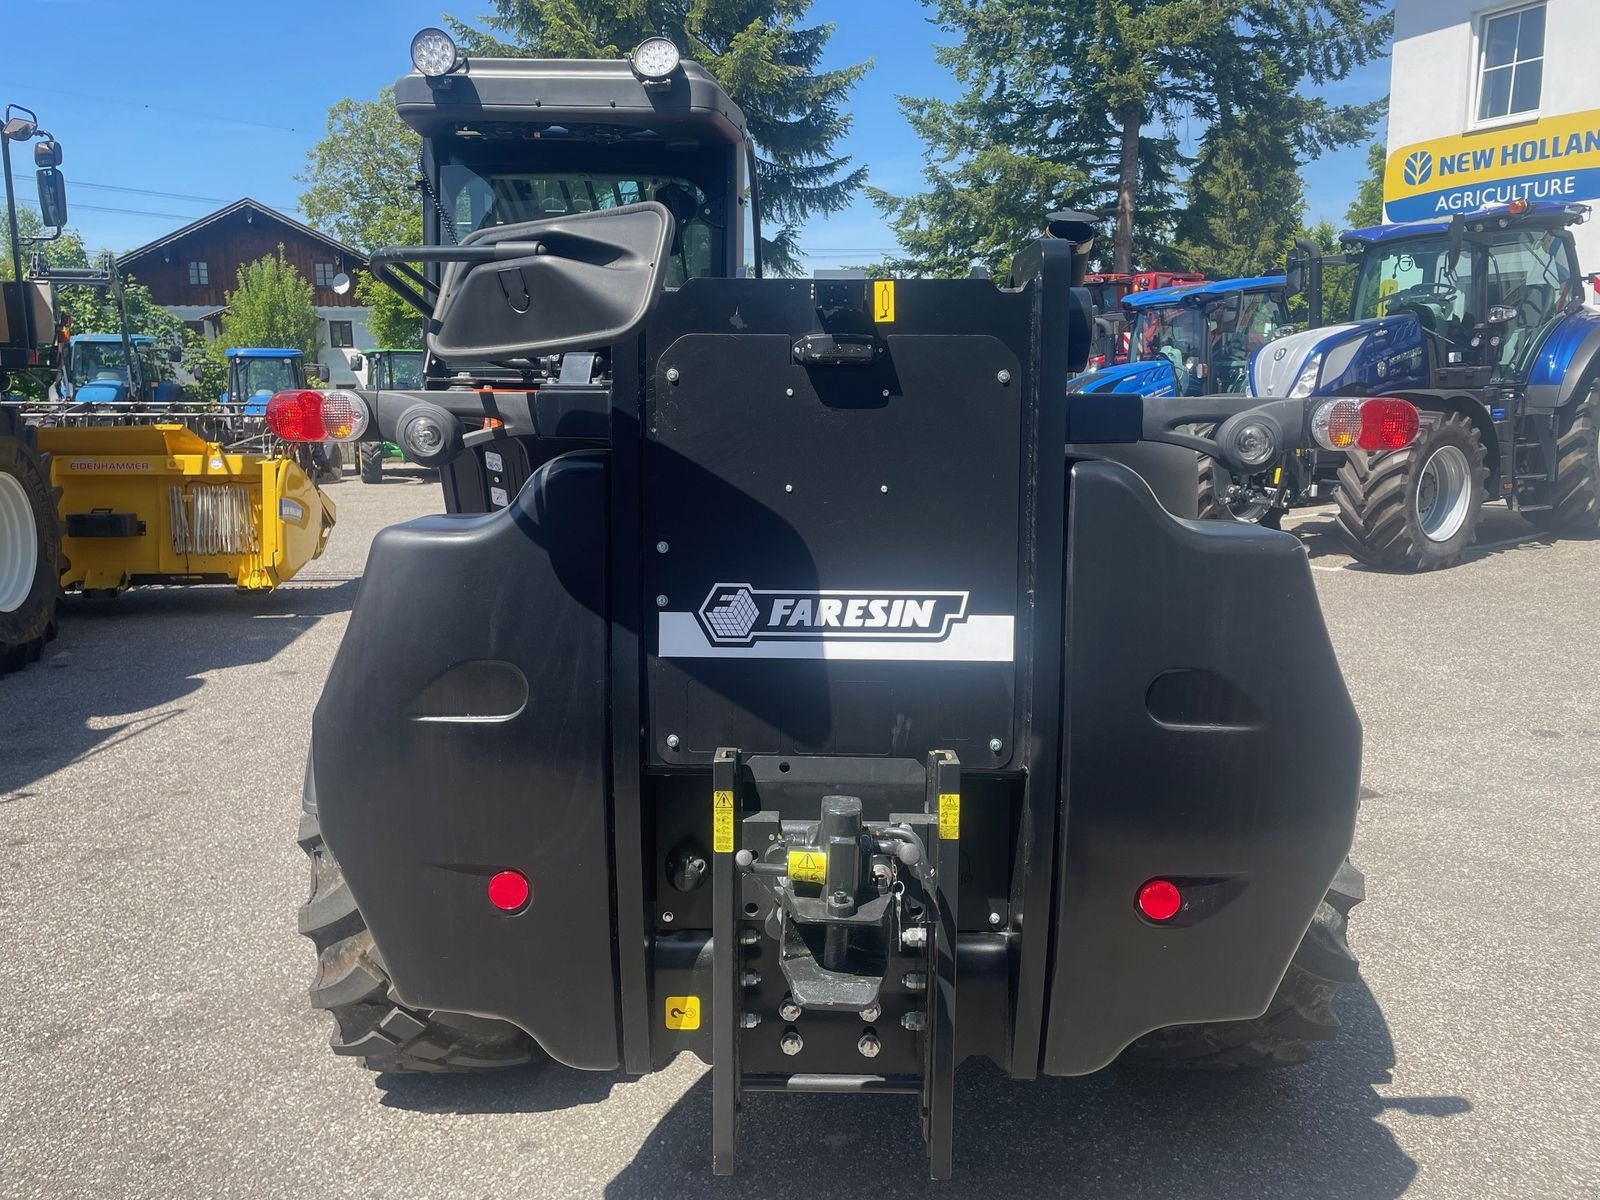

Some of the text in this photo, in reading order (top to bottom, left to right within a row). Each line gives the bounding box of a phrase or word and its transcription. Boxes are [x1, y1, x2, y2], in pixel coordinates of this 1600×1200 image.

[1439, 147, 1495, 176] NEW
[1434, 176, 1576, 212] AGRICULTURE
[70, 462, 149, 471] EIDENHAMMER
[767, 598, 937, 628] FARESIN
